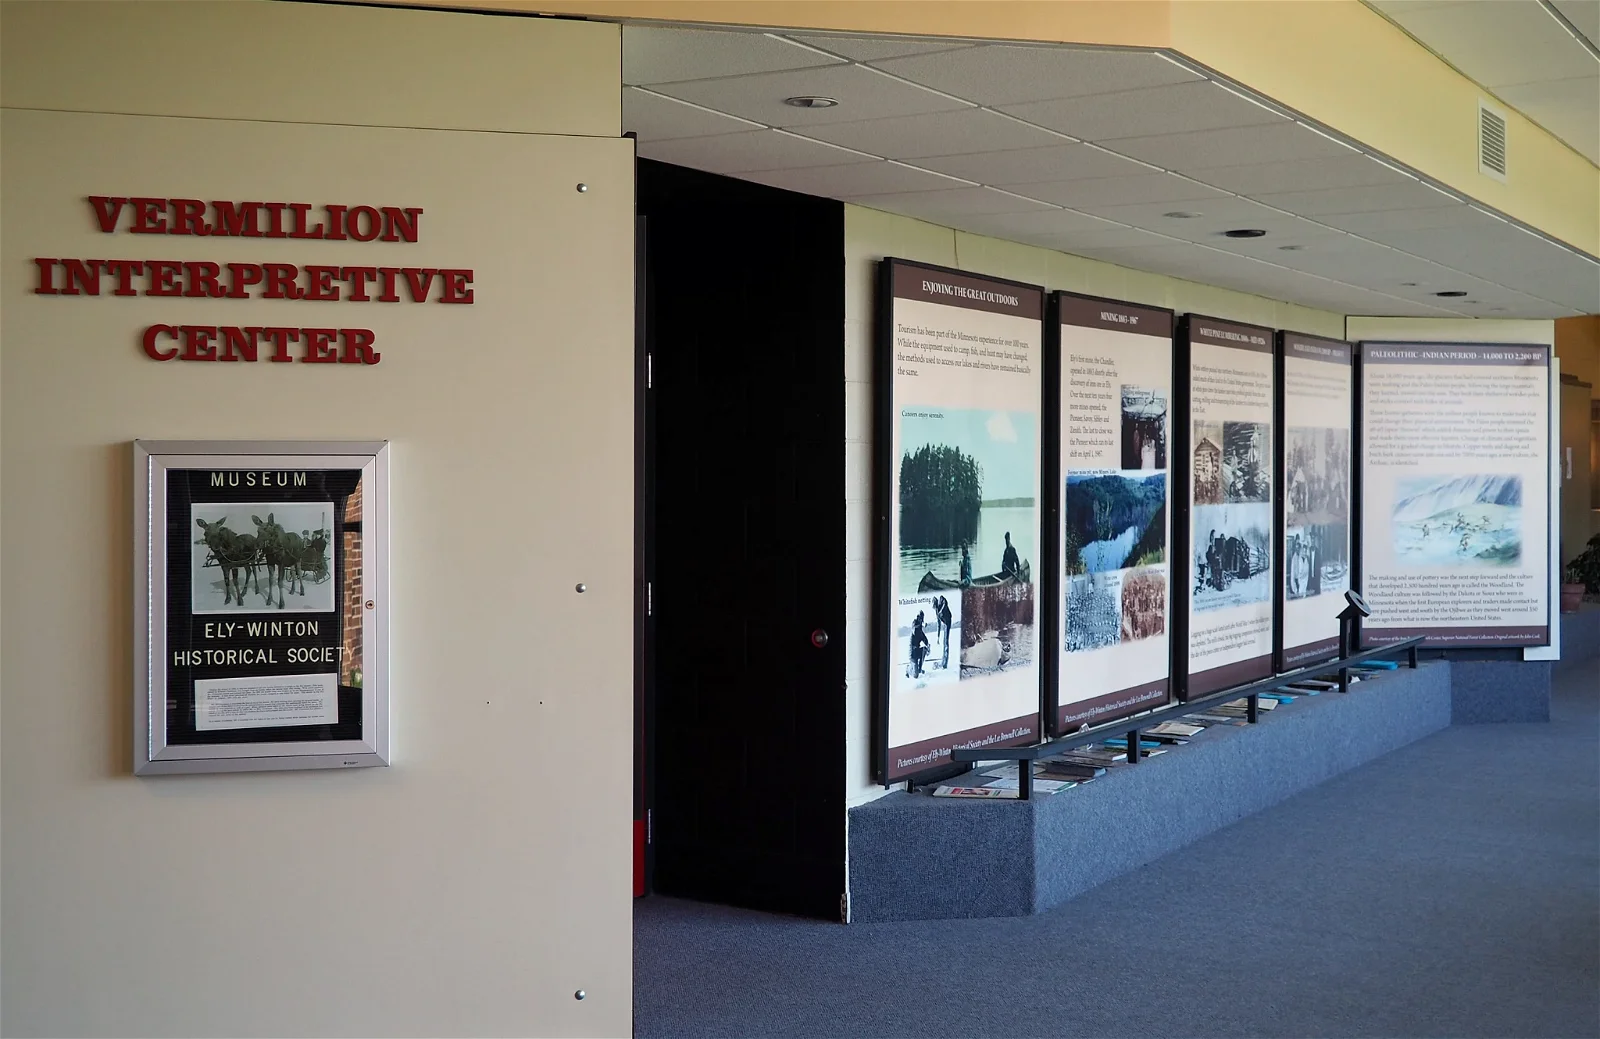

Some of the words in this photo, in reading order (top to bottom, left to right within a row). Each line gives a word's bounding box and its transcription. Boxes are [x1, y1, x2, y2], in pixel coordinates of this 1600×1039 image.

[88, 196, 423, 242] VERMILION
[34, 257, 474, 304] INTERPRETIVE
[922, 280, 954, 295] ENJOYING
[954, 286, 966, 298] THE
[967, 288, 986, 300] GREAT
[987, 292, 1018, 306] OUTDOORS
[142, 323, 380, 365] CENTER
[211, 472, 307, 487] MUSEUM
[205, 621, 319, 639] ELY-WINTON
[174, 648, 277, 666] HISTORICAL
